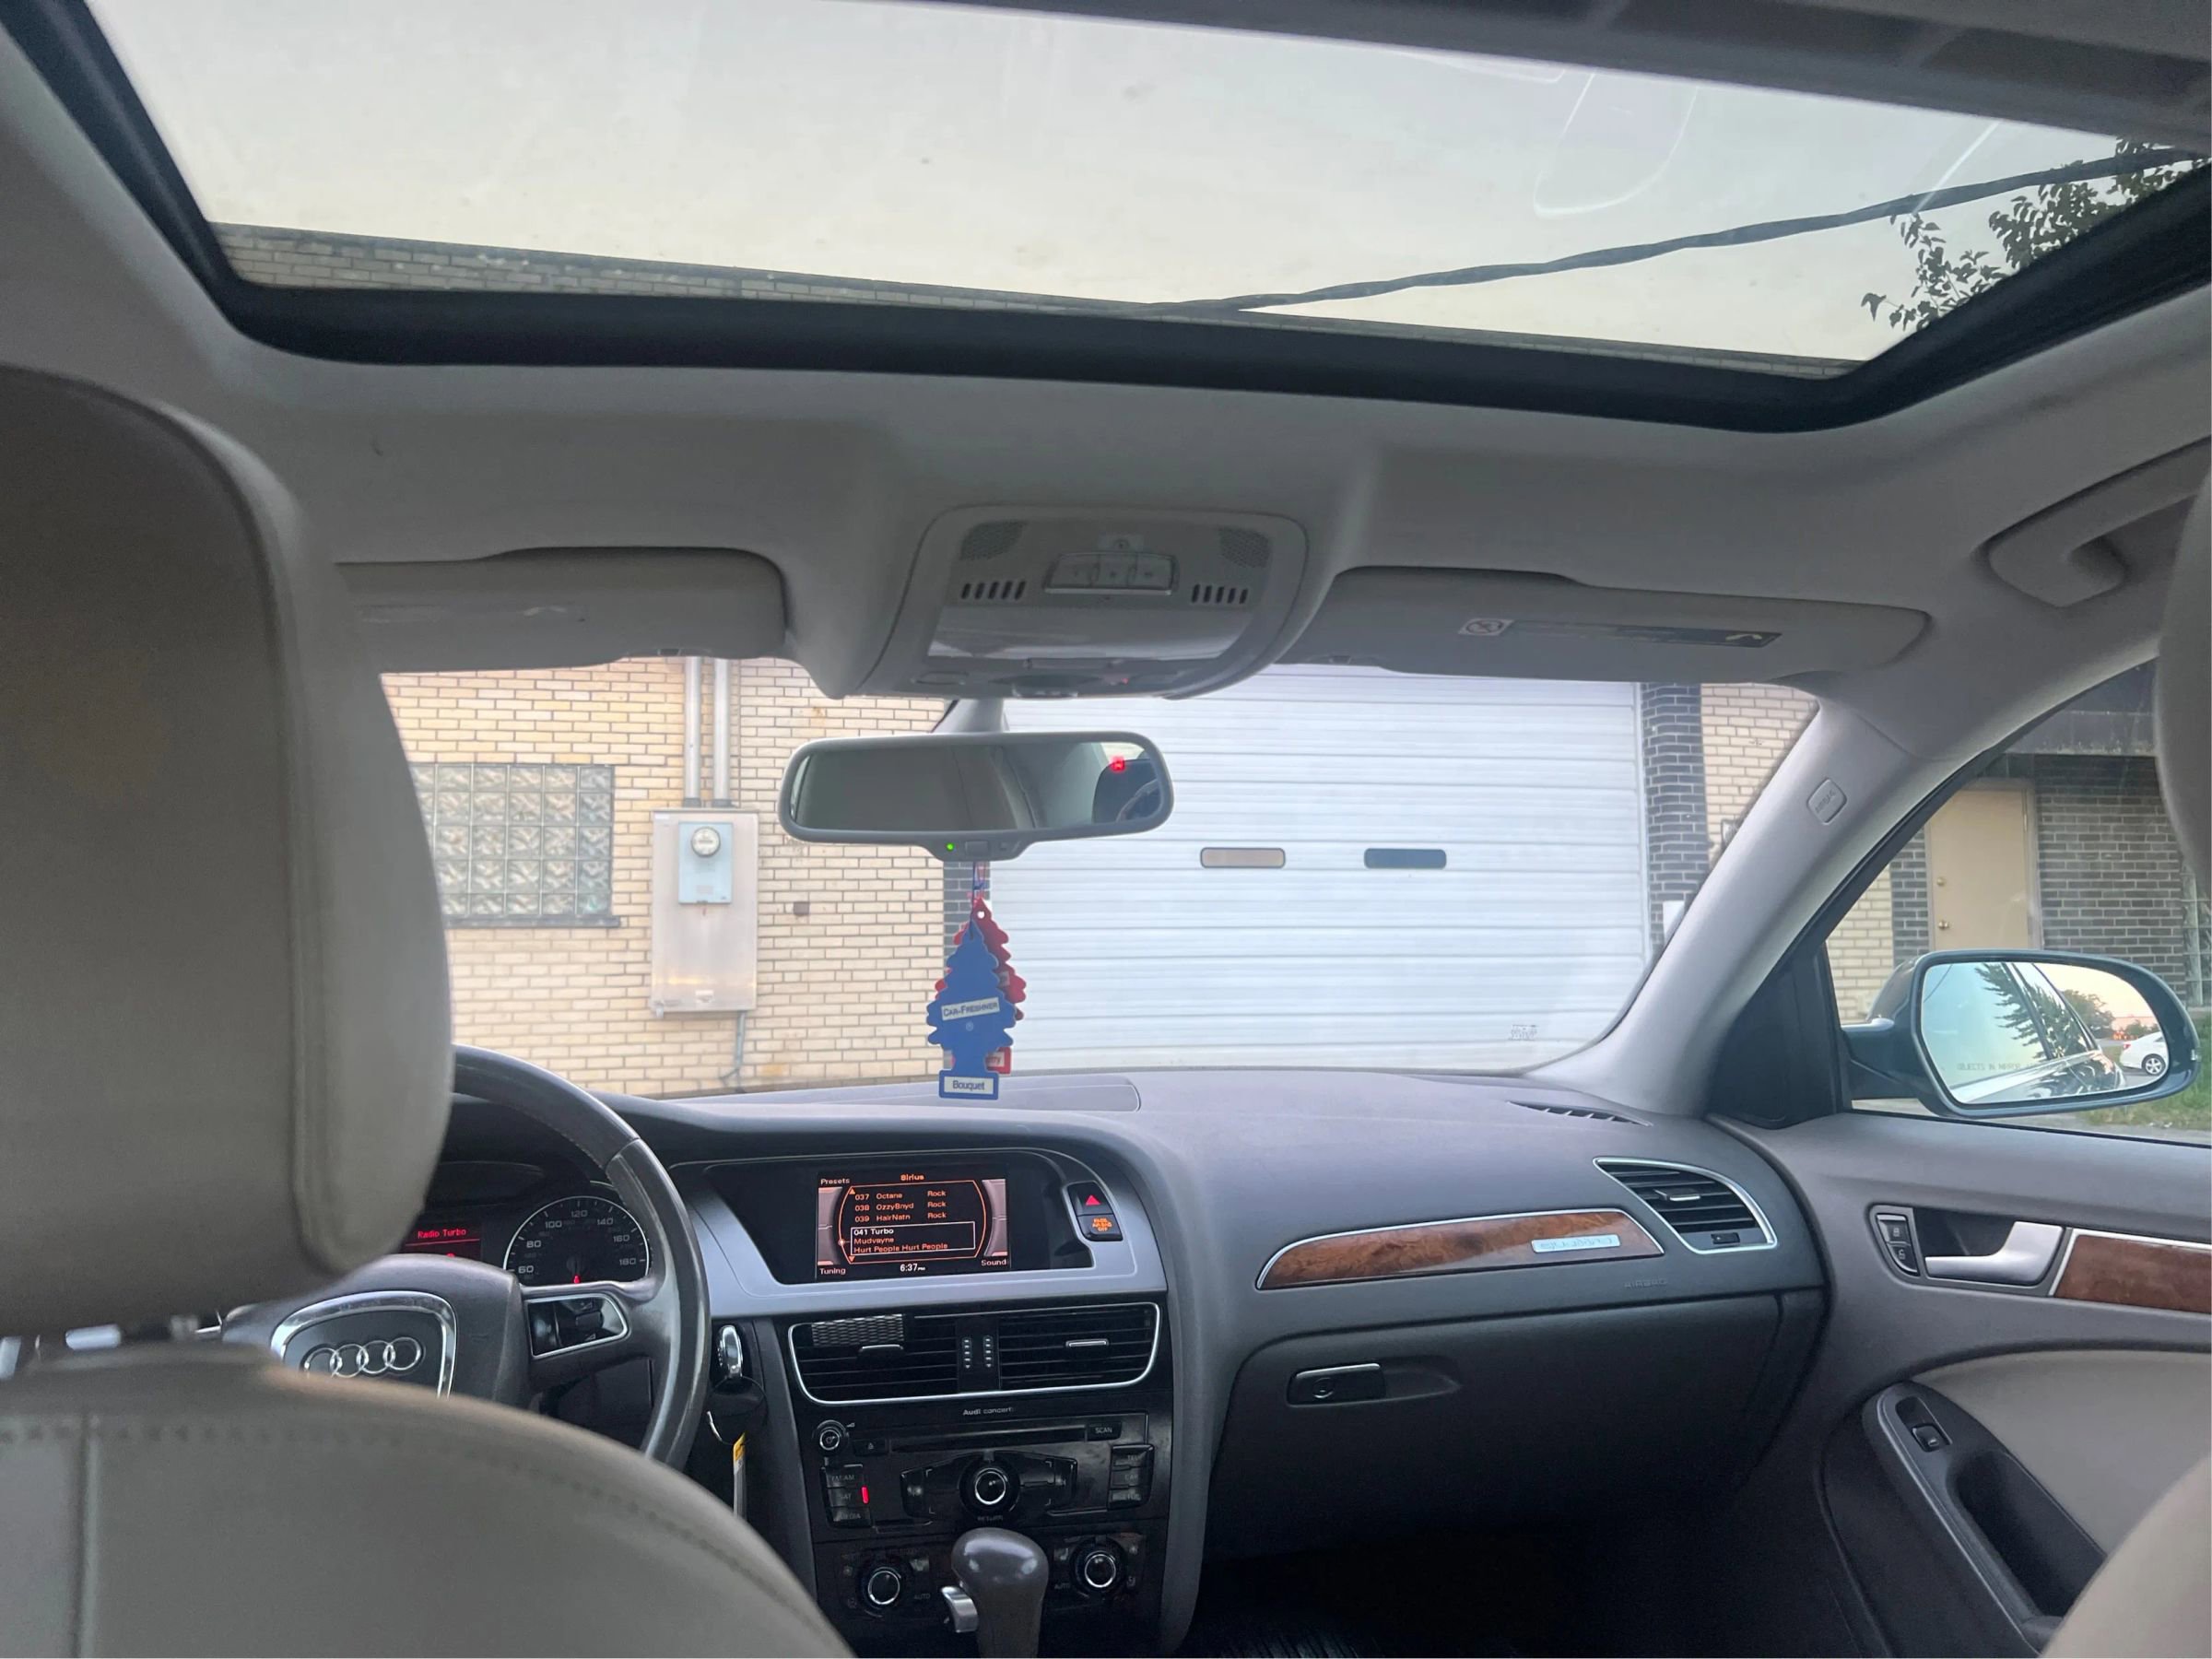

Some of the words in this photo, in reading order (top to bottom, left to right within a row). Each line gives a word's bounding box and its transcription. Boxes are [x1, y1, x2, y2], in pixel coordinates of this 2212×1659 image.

[952, 1080, 985, 1091] Bouquet
[876, 1192, 903, 1200] Octane
[876, 1202, 914, 1211] OzzyBnyd
[571, 1209, 588, 1218] 120
[854, 1215, 870, 1223] 039
[876, 1213, 911, 1221] HairNatn
[927, 1211, 947, 1219] Rock
[545, 1220, 562, 1229] 100
[596, 1218, 614, 1226] 140
[418, 1230, 441, 1239] Radio
[442, 1228, 466, 1237] Turbo
[613, 1234, 630, 1242] 160
[526, 1240, 542, 1248] 80
[853, 1237, 894, 1245] Mudvayne
[518, 1265, 535, 1274] 60
[819, 1267, 846, 1276] Tuning
[982, 1406, 1013, 1415] concert
